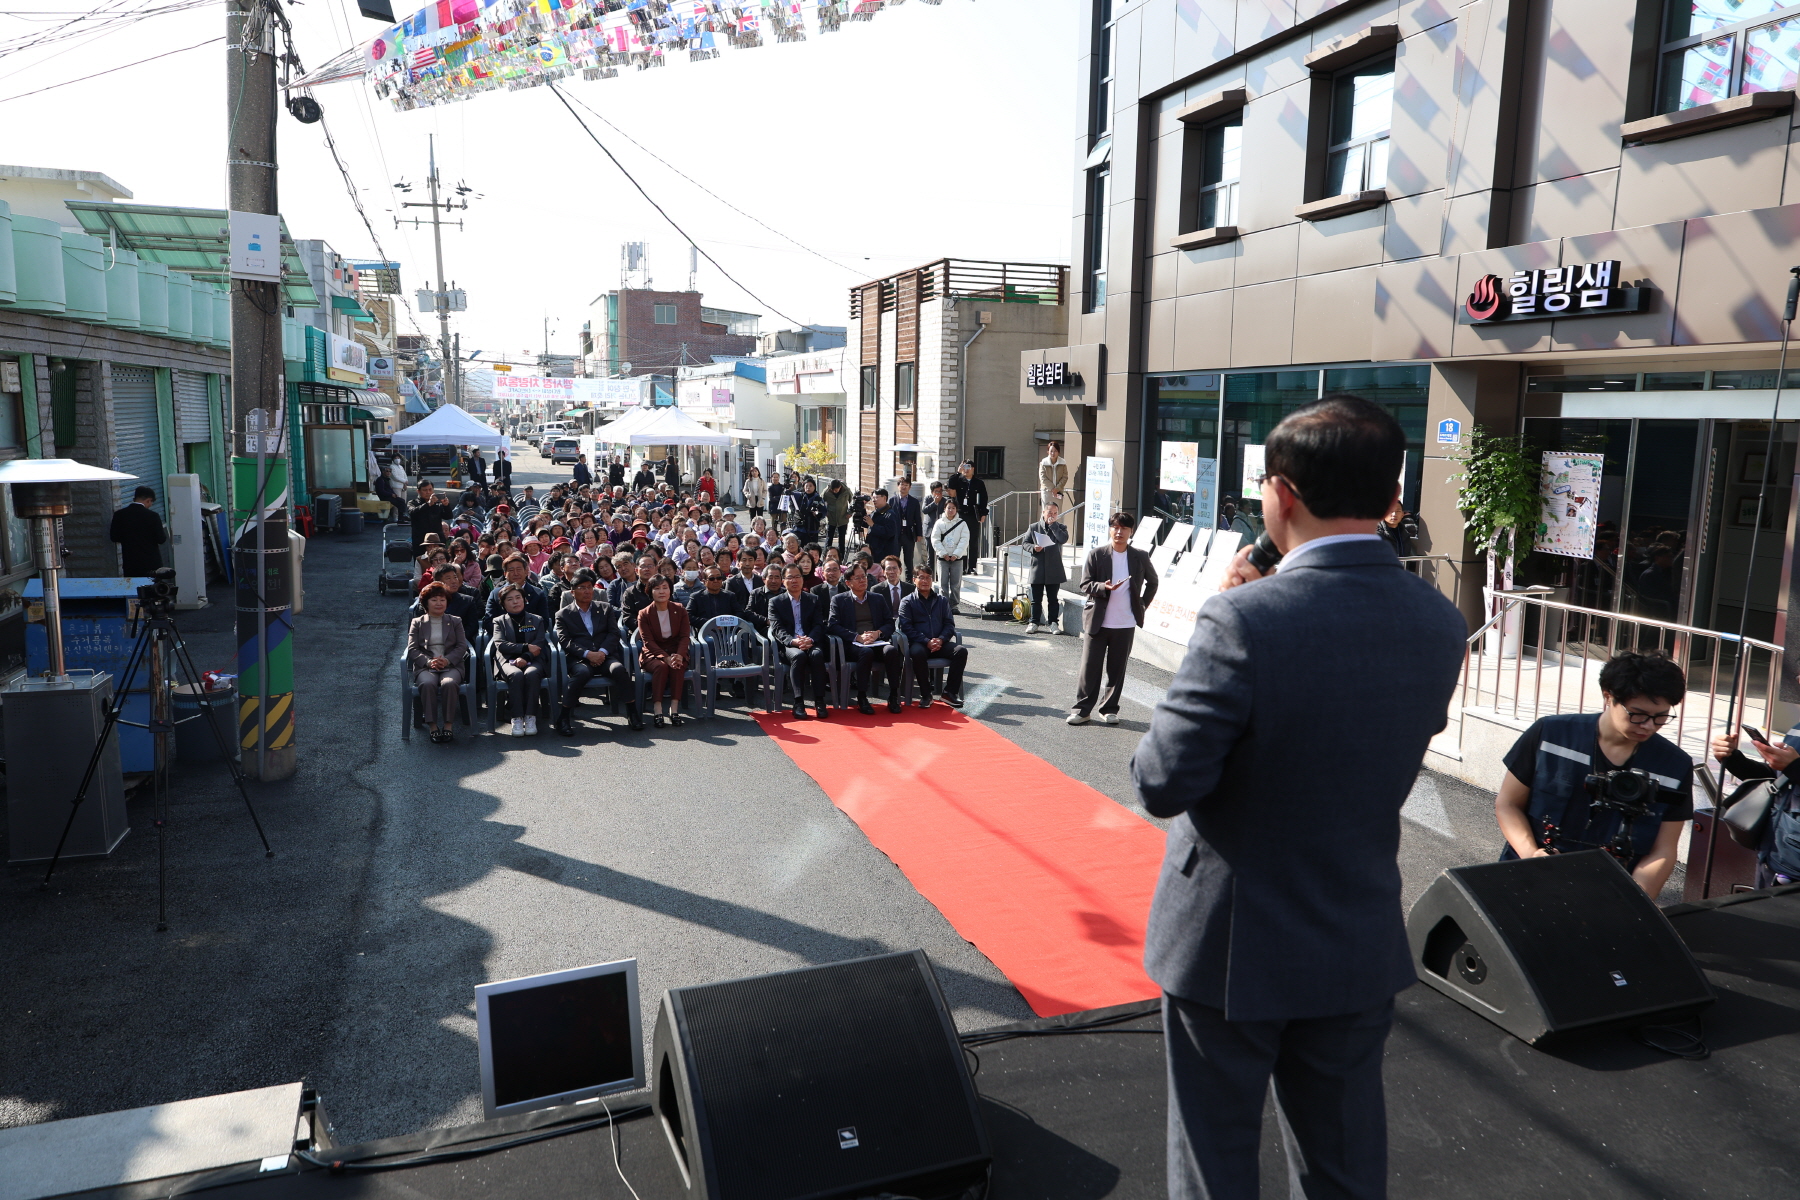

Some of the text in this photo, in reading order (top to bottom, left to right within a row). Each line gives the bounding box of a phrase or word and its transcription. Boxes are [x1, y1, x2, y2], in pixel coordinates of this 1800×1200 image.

[1509, 259, 1613, 315] 힐링샘
[1027, 362, 1064, 386] 힐링쉼터
[1445, 422, 1454, 432] 18
